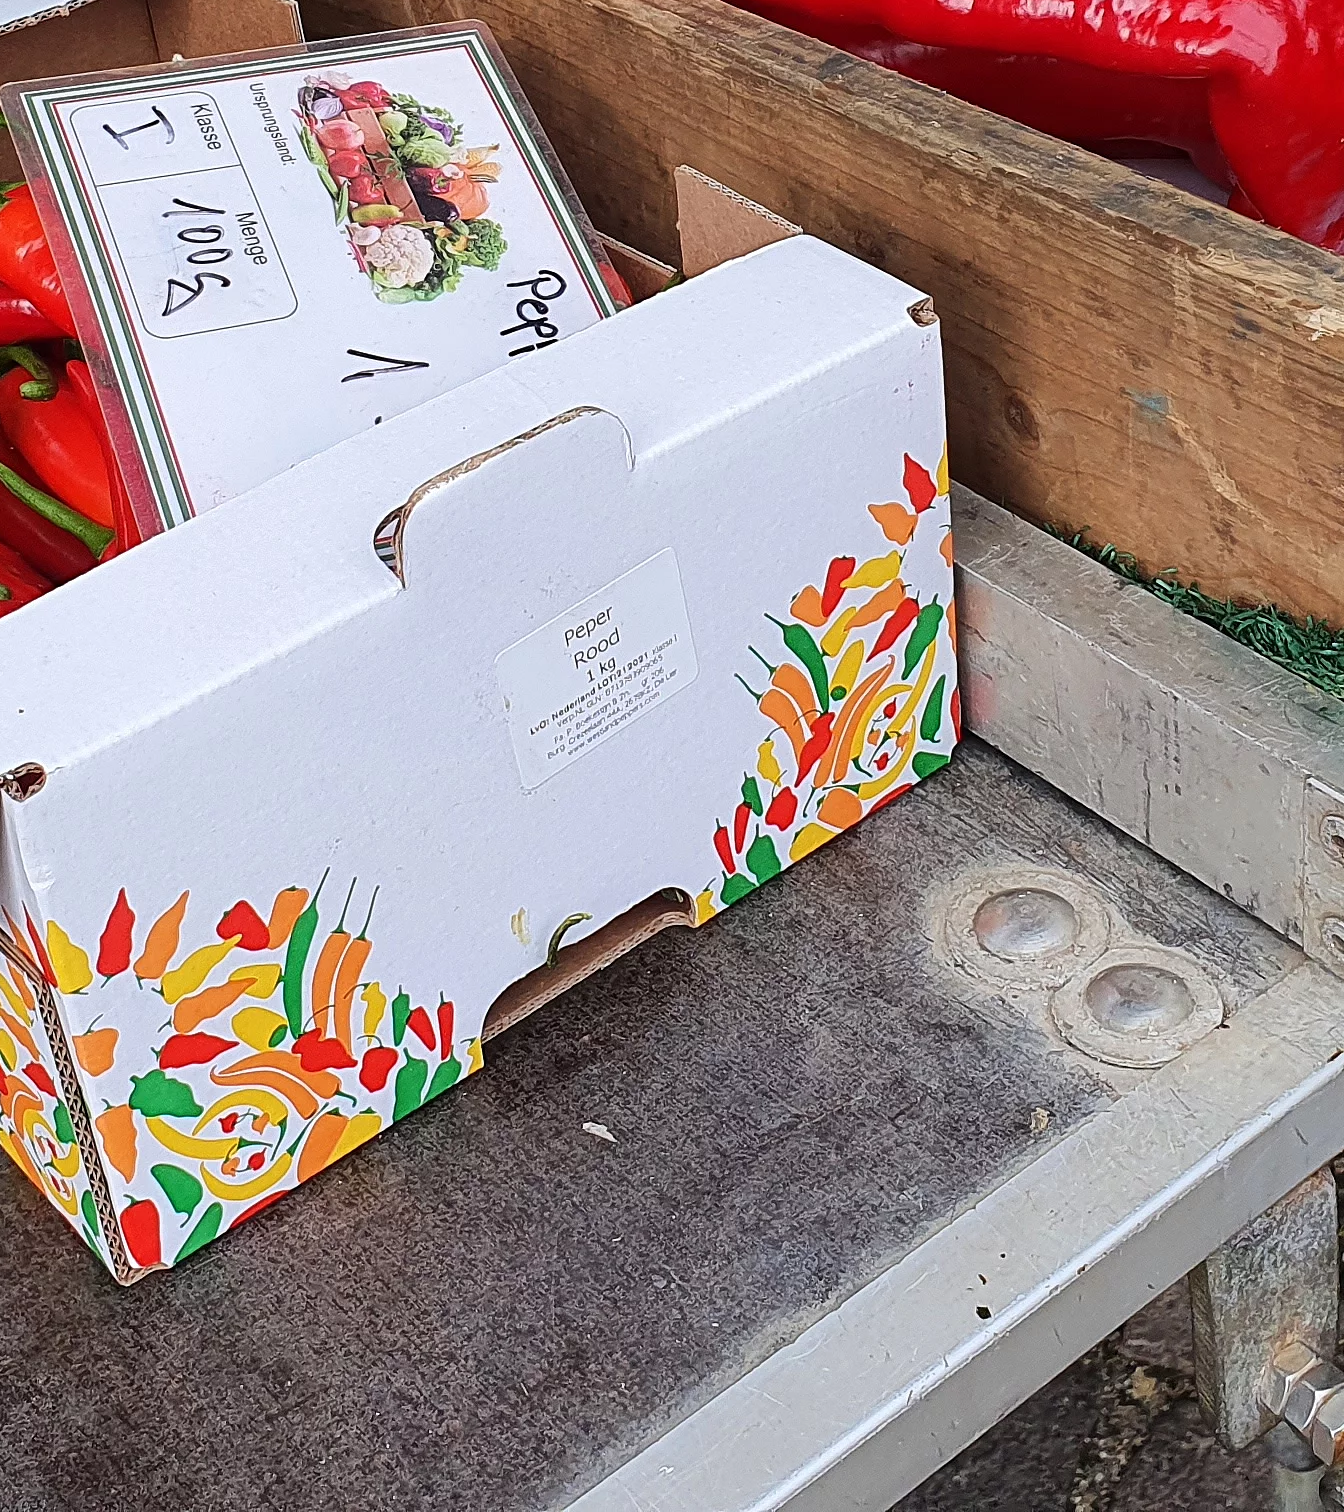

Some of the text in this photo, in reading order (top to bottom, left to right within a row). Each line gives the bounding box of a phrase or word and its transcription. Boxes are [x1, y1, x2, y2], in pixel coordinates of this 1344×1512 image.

[190, 103, 222, 150] Klasse
[249, 82, 296, 167] Ursprungsland:
[235, 211, 268, 266] Menge
[564, 606, 613, 648] Peper
[574, 627, 620, 670] Rood
[587, 657, 616, 684] 1 kg
[552, 688, 596, 722] Nederland
